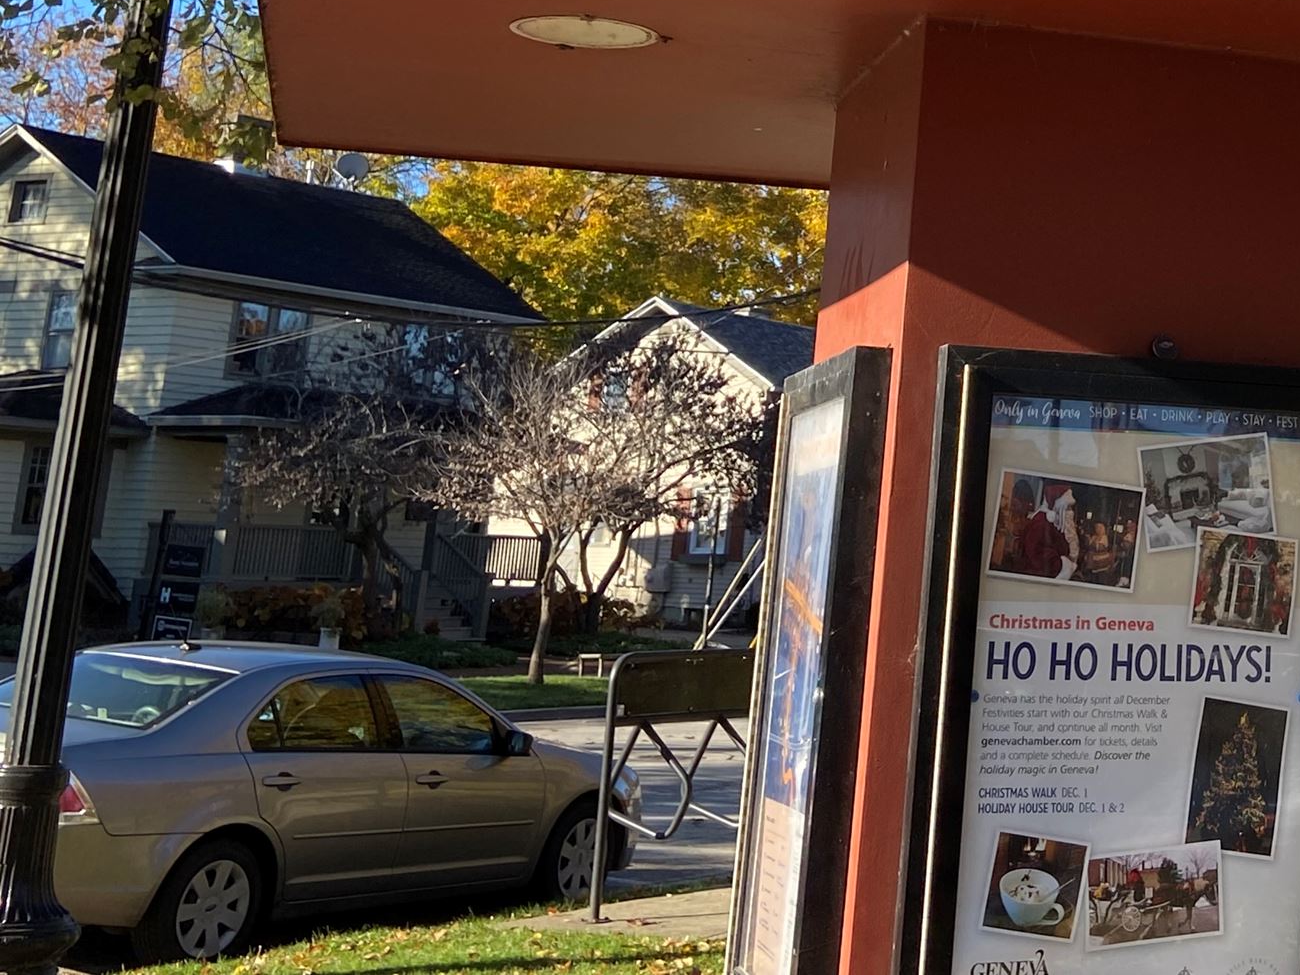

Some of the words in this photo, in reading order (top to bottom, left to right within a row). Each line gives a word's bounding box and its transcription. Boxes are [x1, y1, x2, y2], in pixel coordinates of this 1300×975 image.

[995, 400, 1023, 424] Only
[1027, 404, 1039, 419] in
[1042, 402, 1081, 424] Geneva
[1089, 406, 1117, 419] SHOP
[1130, 407, 1148, 421] EAT
[1161, 409, 1194, 422] DRINK
[1205, 411, 1231, 424] PLAY
[1242, 413, 1266, 426] STAY
[1276, 415, 1298, 428] FEST
[989, 613, 1071, 629] Christmas
[1076, 615, 1090, 630] in
[1096, 616, 1154, 631] Geneva
[986, 641, 1037, 680] HO
[1049, 642, 1098, 681] HO
[1111, 643, 1272, 683] HOLIDAYS!
[983, 693, 1017, 704] Geneva
[1020, 693, 1036, 704] has
[1039, 693, 1053, 704] the
[1056, 694, 1088, 707] holiday
[1114, 694, 1125, 705] all
[983, 707, 1025, 718] Festivities
[1026, 708, 1047, 718] start
[1051, 708, 1070, 718] with
[1073, 710, 1088, 719] our
[1091, 708, 1134, 719] Christmas
[1137, 708, 1158, 719] Walk
[1161, 709, 1168, 719] &
[982, 722, 1010, 732] House
[1037, 723, 1055, 732] and
[1058, 723, 1096, 733] continue
[1098, 722, 1108, 732] all
[1146, 723, 1163, 733] Visit
[981, 736, 1081, 748] genevachamber.com
[1084, 736, 1096, 746] for
[1100, 736, 1128, 747] tickets,
[1131, 736, 1158, 746] details
[979, 750, 998, 760] and
[1000, 752, 1006, 760] a
[1008, 750, 1049, 763] complete
[1094, 750, 1133, 761] Discover
[1135, 750, 1151, 761] the
[979, 765, 1015, 777] holiday
[1018, 765, 1047, 777] magic
[1049, 764, 1057, 774] in
[1060, 765, 1099, 775] Geneva!
[978, 787, 1029, 799] CHRISTMAS
[1032, 787, 1057, 799] WALK
[1061, 787, 1081, 798] DEC.
[1084, 788, 1088, 798] 1
[978, 802, 1016, 814] HOLIDAY
[1019, 802, 1048, 814] HOUSE
[1051, 802, 1074, 814] TOUR
[1079, 802, 1098, 814] DEC.
[1101, 803, 1106, 814] 1
[1108, 803, 1118, 813] &
[1119, 803, 1126, 814] 2
[970, 949, 1049, 975] GENEVA
